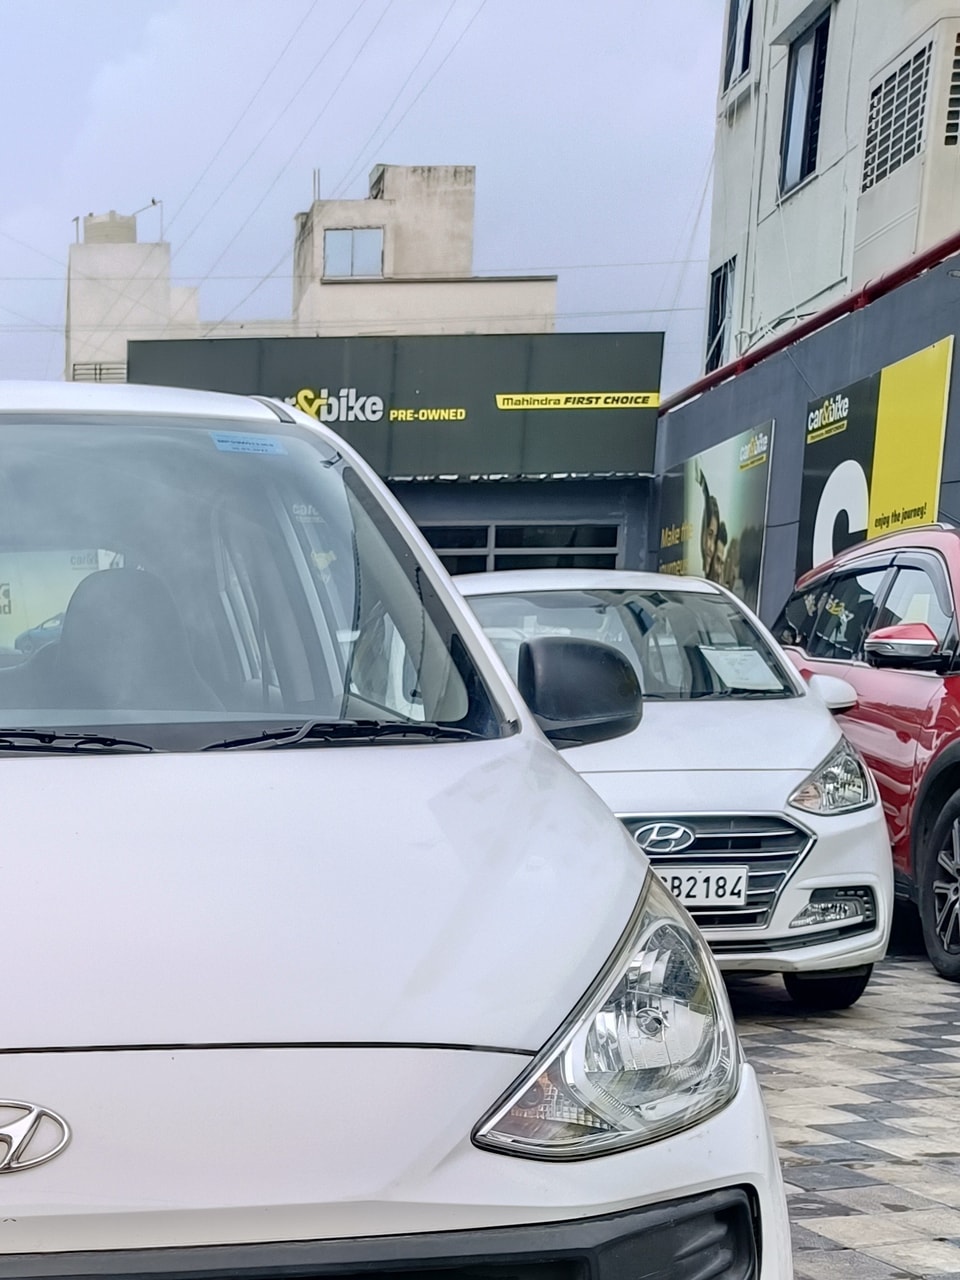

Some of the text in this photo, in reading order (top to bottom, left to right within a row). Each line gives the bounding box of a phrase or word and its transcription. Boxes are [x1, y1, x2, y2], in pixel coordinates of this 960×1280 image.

[502, 395, 650, 407] Mahindra FIRST CHOICE
[389, 409, 466, 421] PRE-OWNED
[808, 394, 849, 431] car&bike
